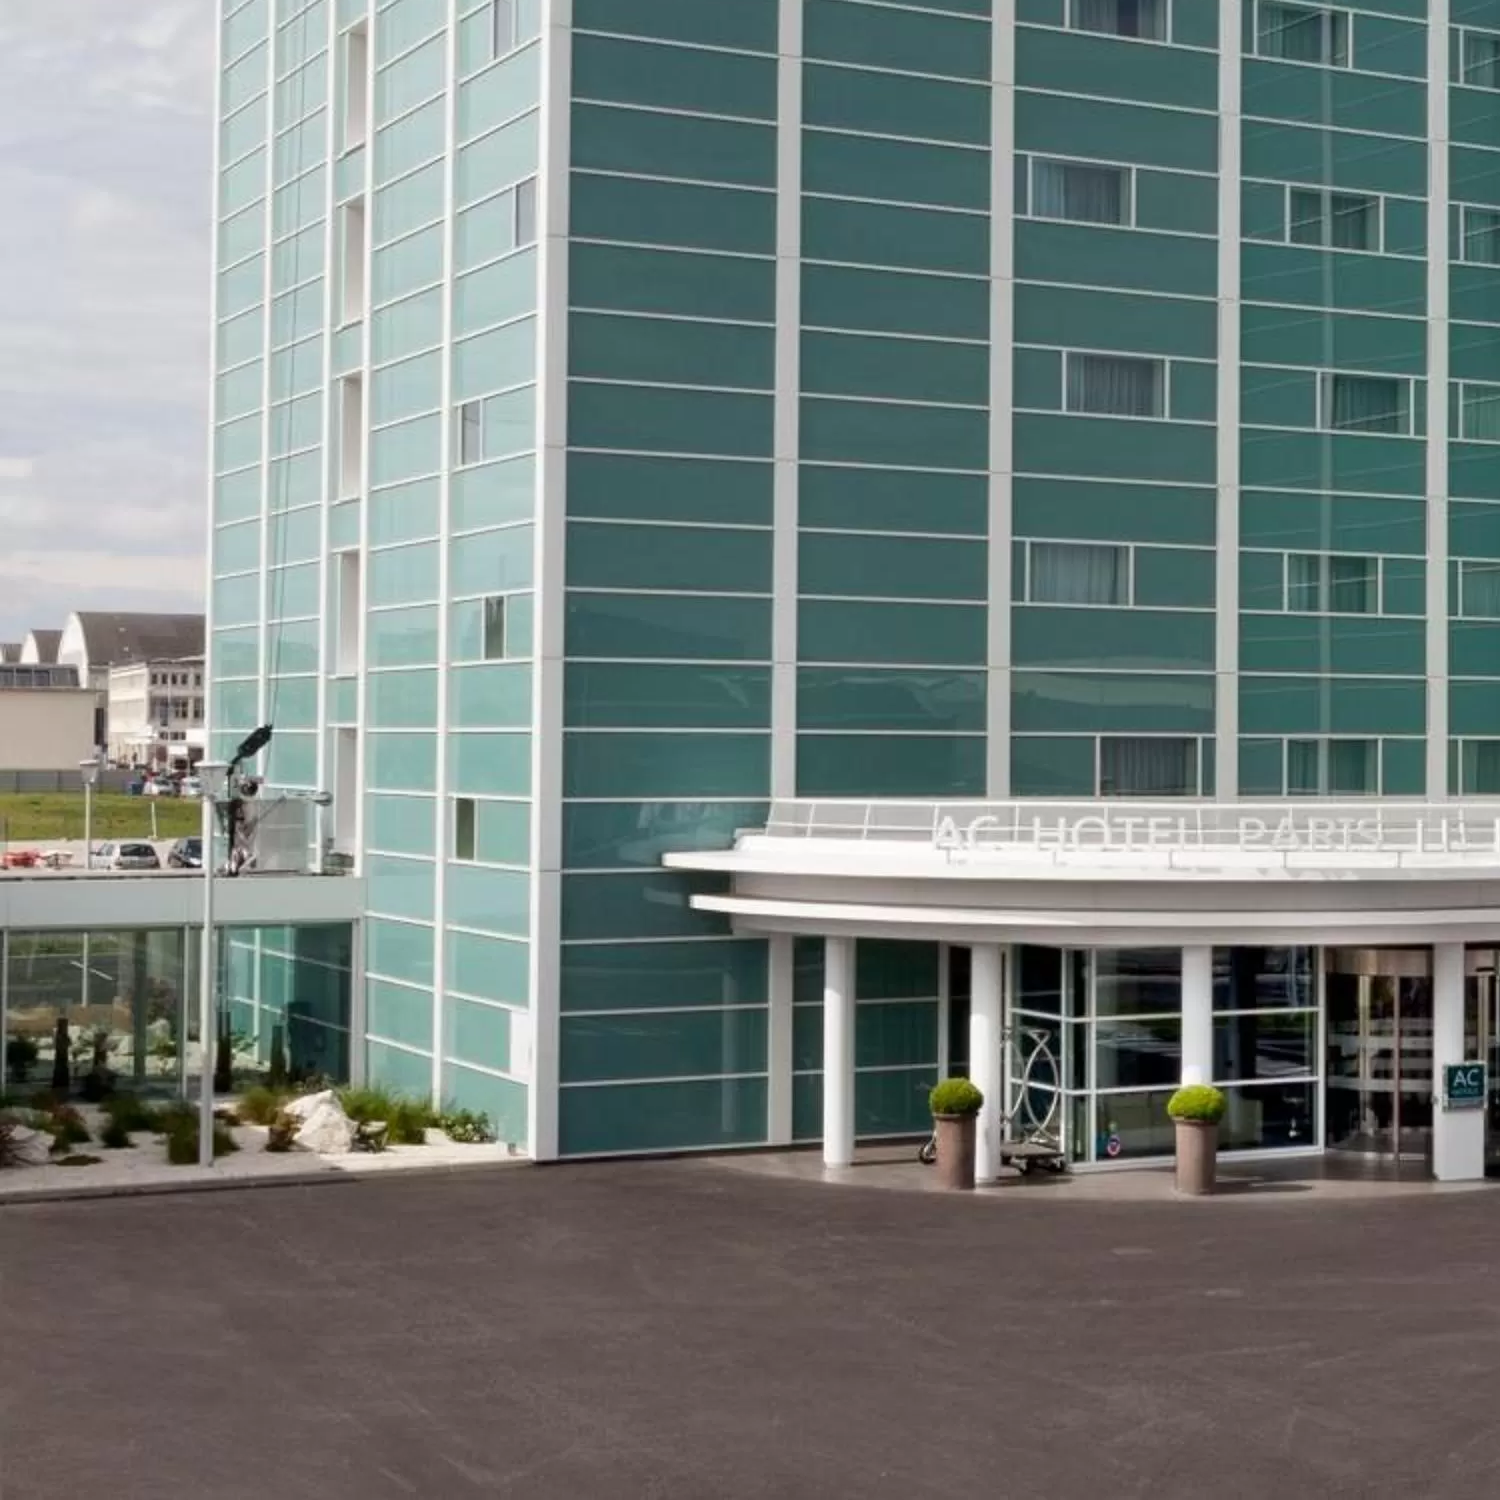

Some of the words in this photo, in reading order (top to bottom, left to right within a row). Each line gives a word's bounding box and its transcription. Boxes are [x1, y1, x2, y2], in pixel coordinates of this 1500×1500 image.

[933, 815, 998, 850] AC
[1033, 815, 1200, 851] HOTEL
[1238, 816, 1382, 851] PARIS
[1453, 1068, 1480, 1087] AC
